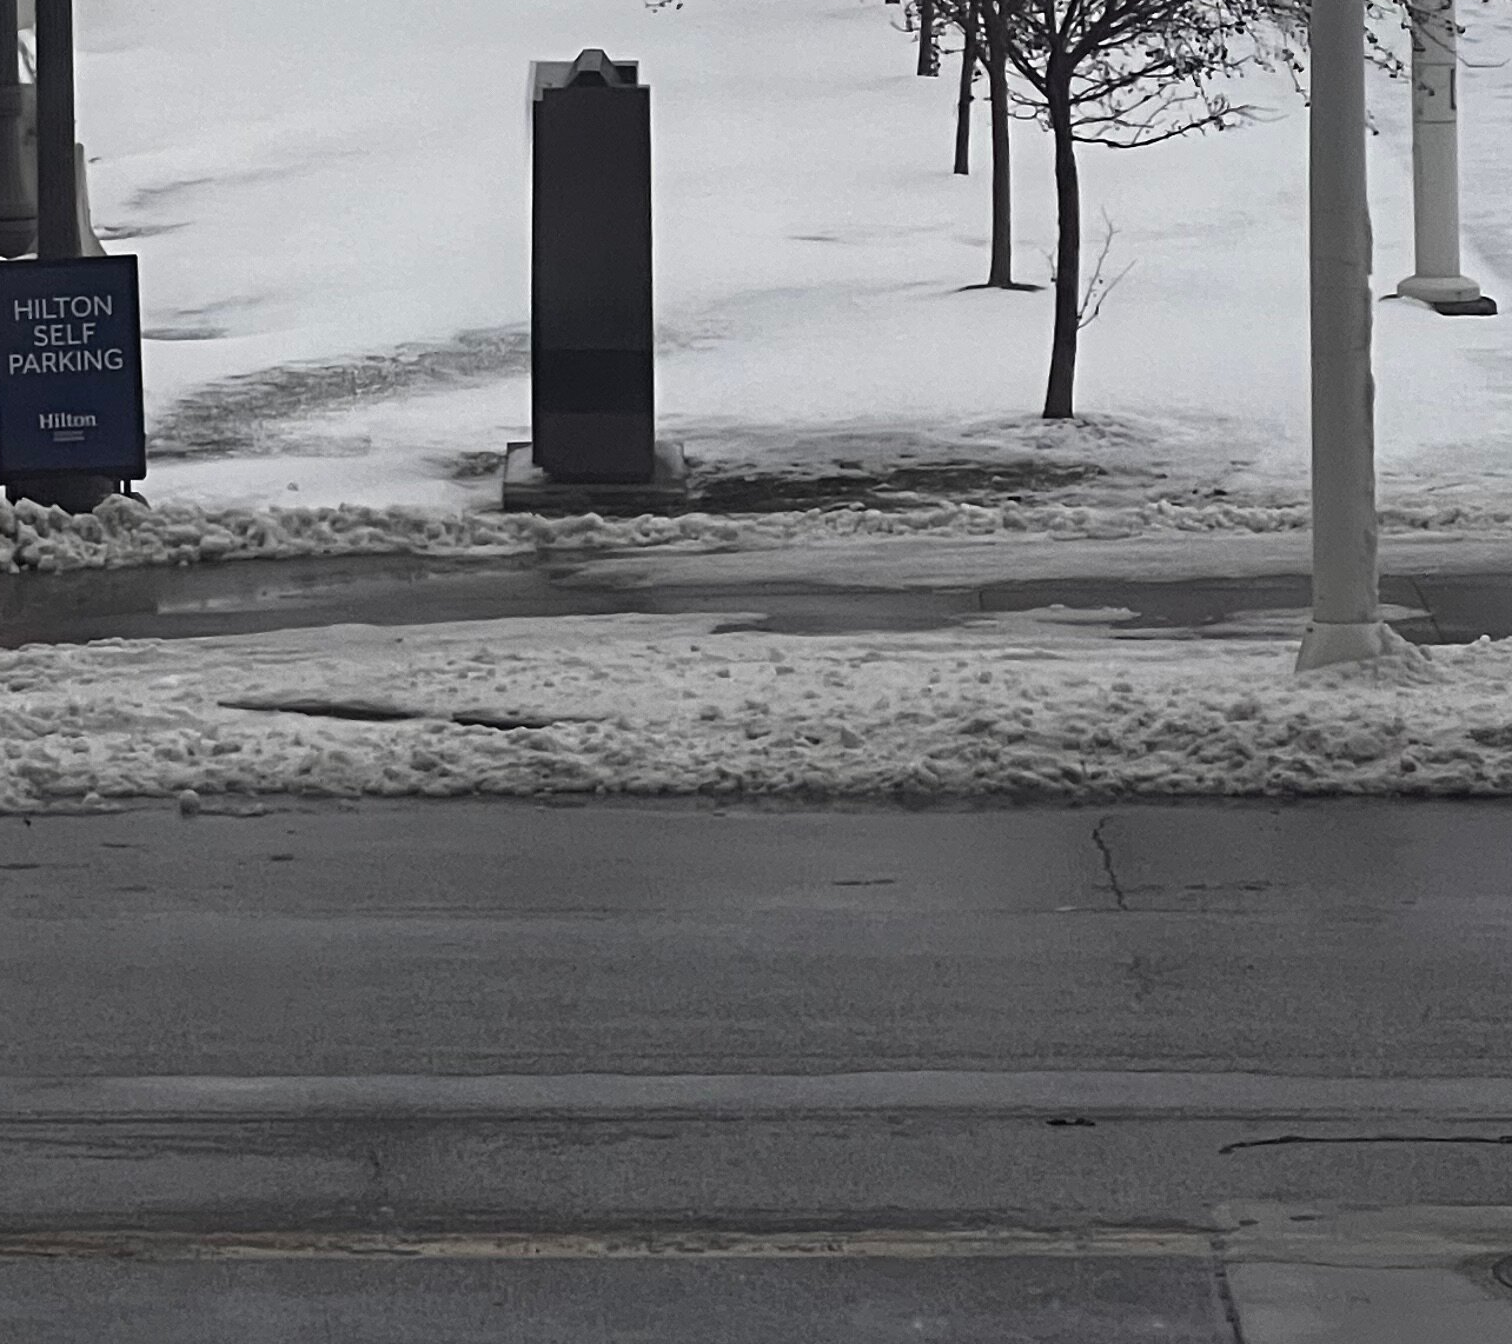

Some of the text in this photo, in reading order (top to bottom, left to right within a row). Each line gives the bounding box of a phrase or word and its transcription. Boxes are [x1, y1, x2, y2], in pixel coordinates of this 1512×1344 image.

[13, 295, 113, 321] HILTON
[33, 322, 97, 347] SELF
[8, 348, 124, 375] PARKING
[39, 412, 97, 429] Hilton
